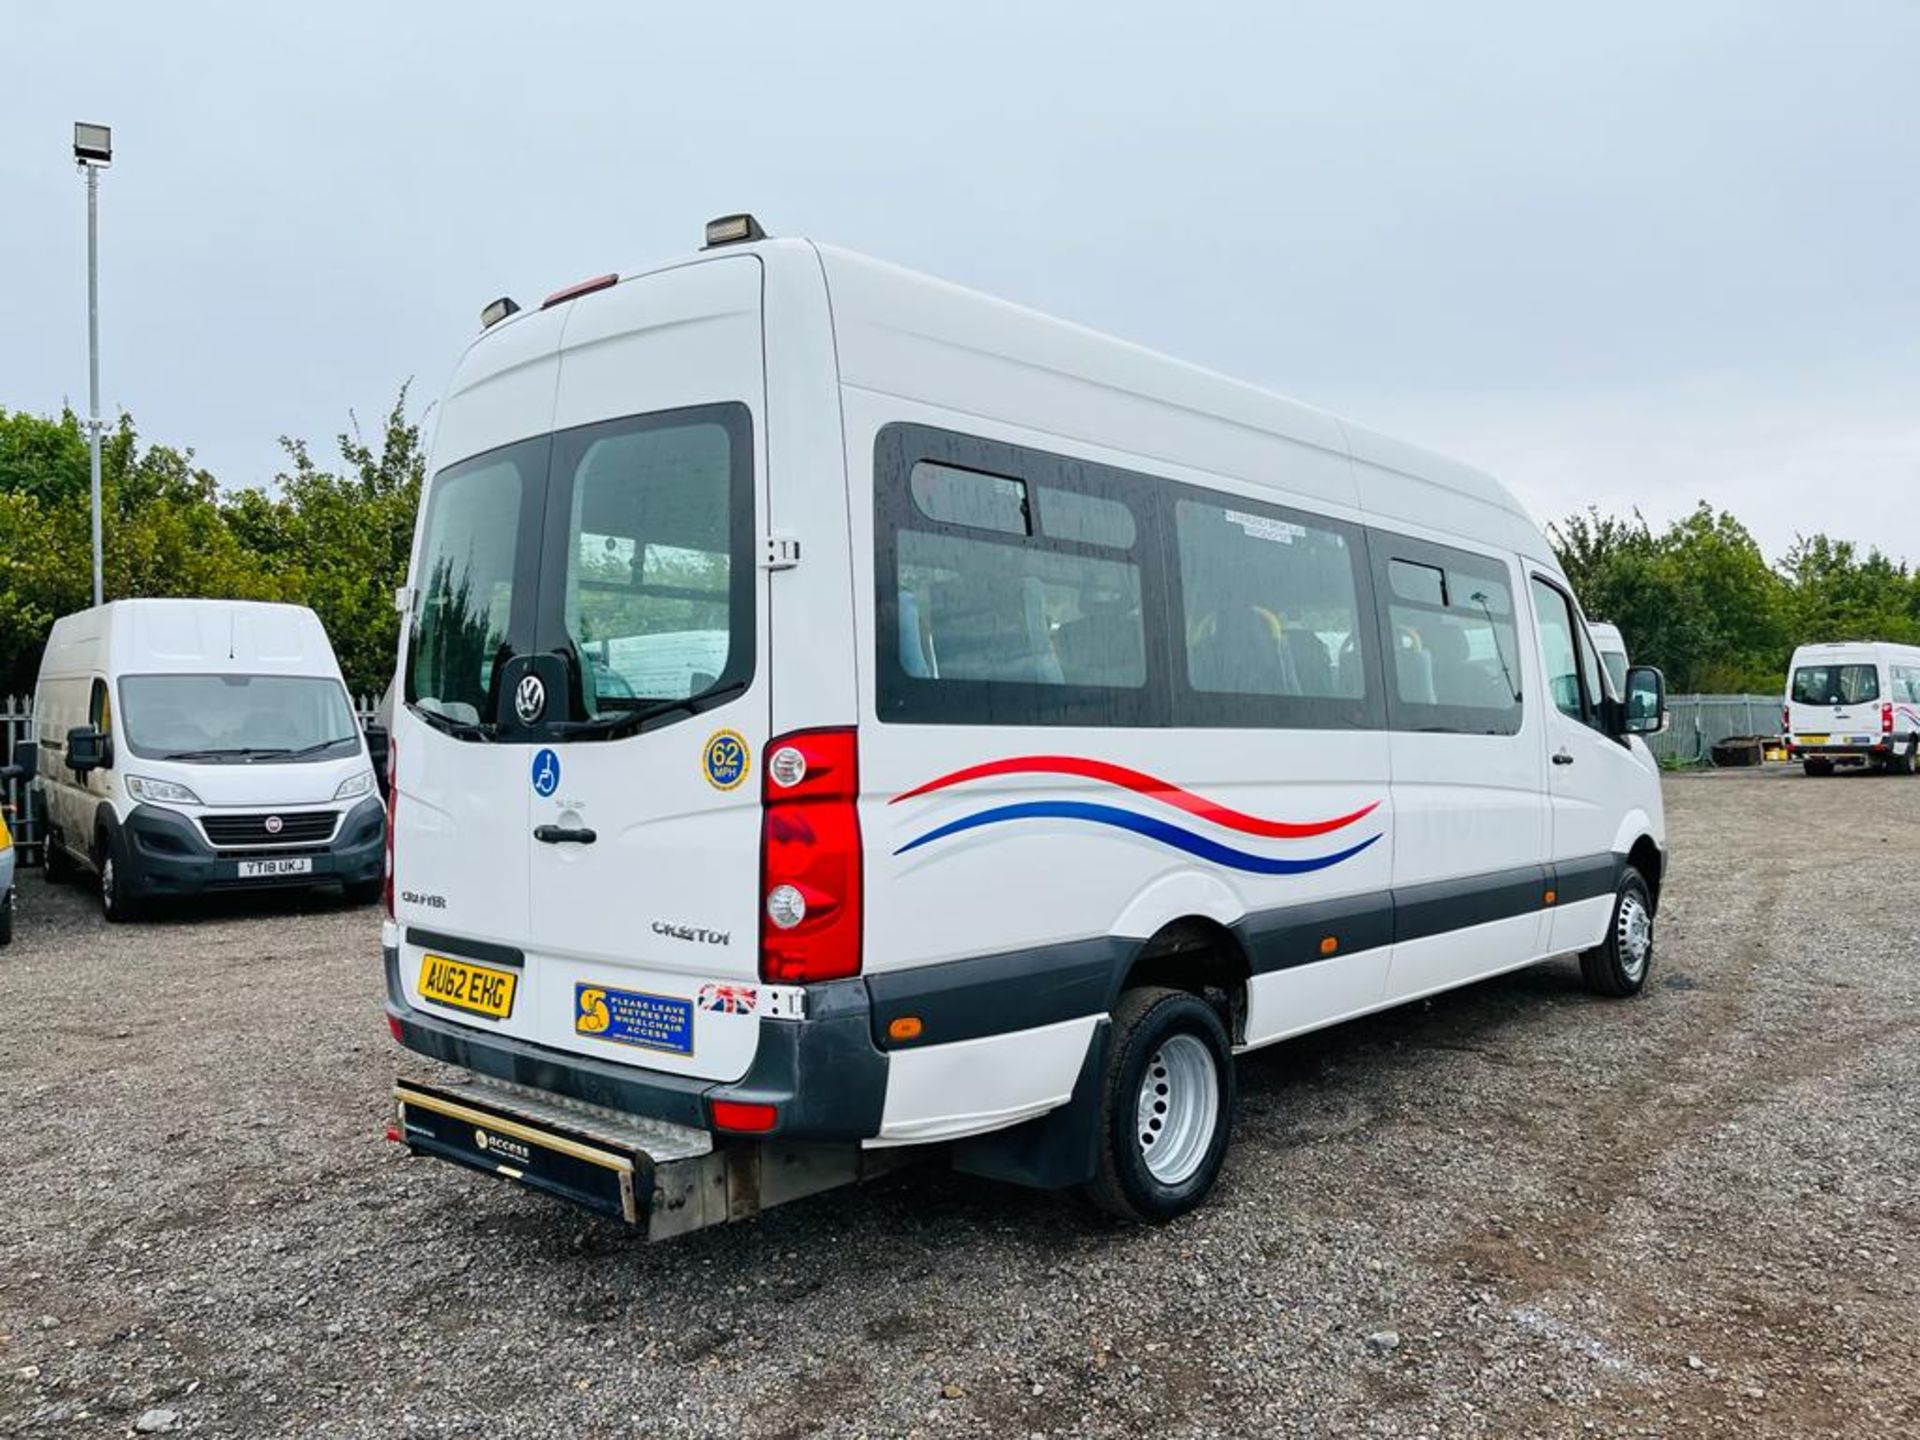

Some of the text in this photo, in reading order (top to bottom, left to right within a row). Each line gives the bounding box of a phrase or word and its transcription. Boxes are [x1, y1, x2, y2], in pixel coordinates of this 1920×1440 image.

[712, 742, 739, 766] 62
[247, 859, 305, 875] YT18 UKJ
[425, 962, 505, 1008] AU62 EHG
[611, 997, 685, 1015] PLEASE LEAVE
[619, 1006, 661, 1020] METRES
[663, 1013, 685, 1024] FOR
[614, 1015, 682, 1032] WHEELCHAIR
[626, 1026, 668, 1039] ACCESS
